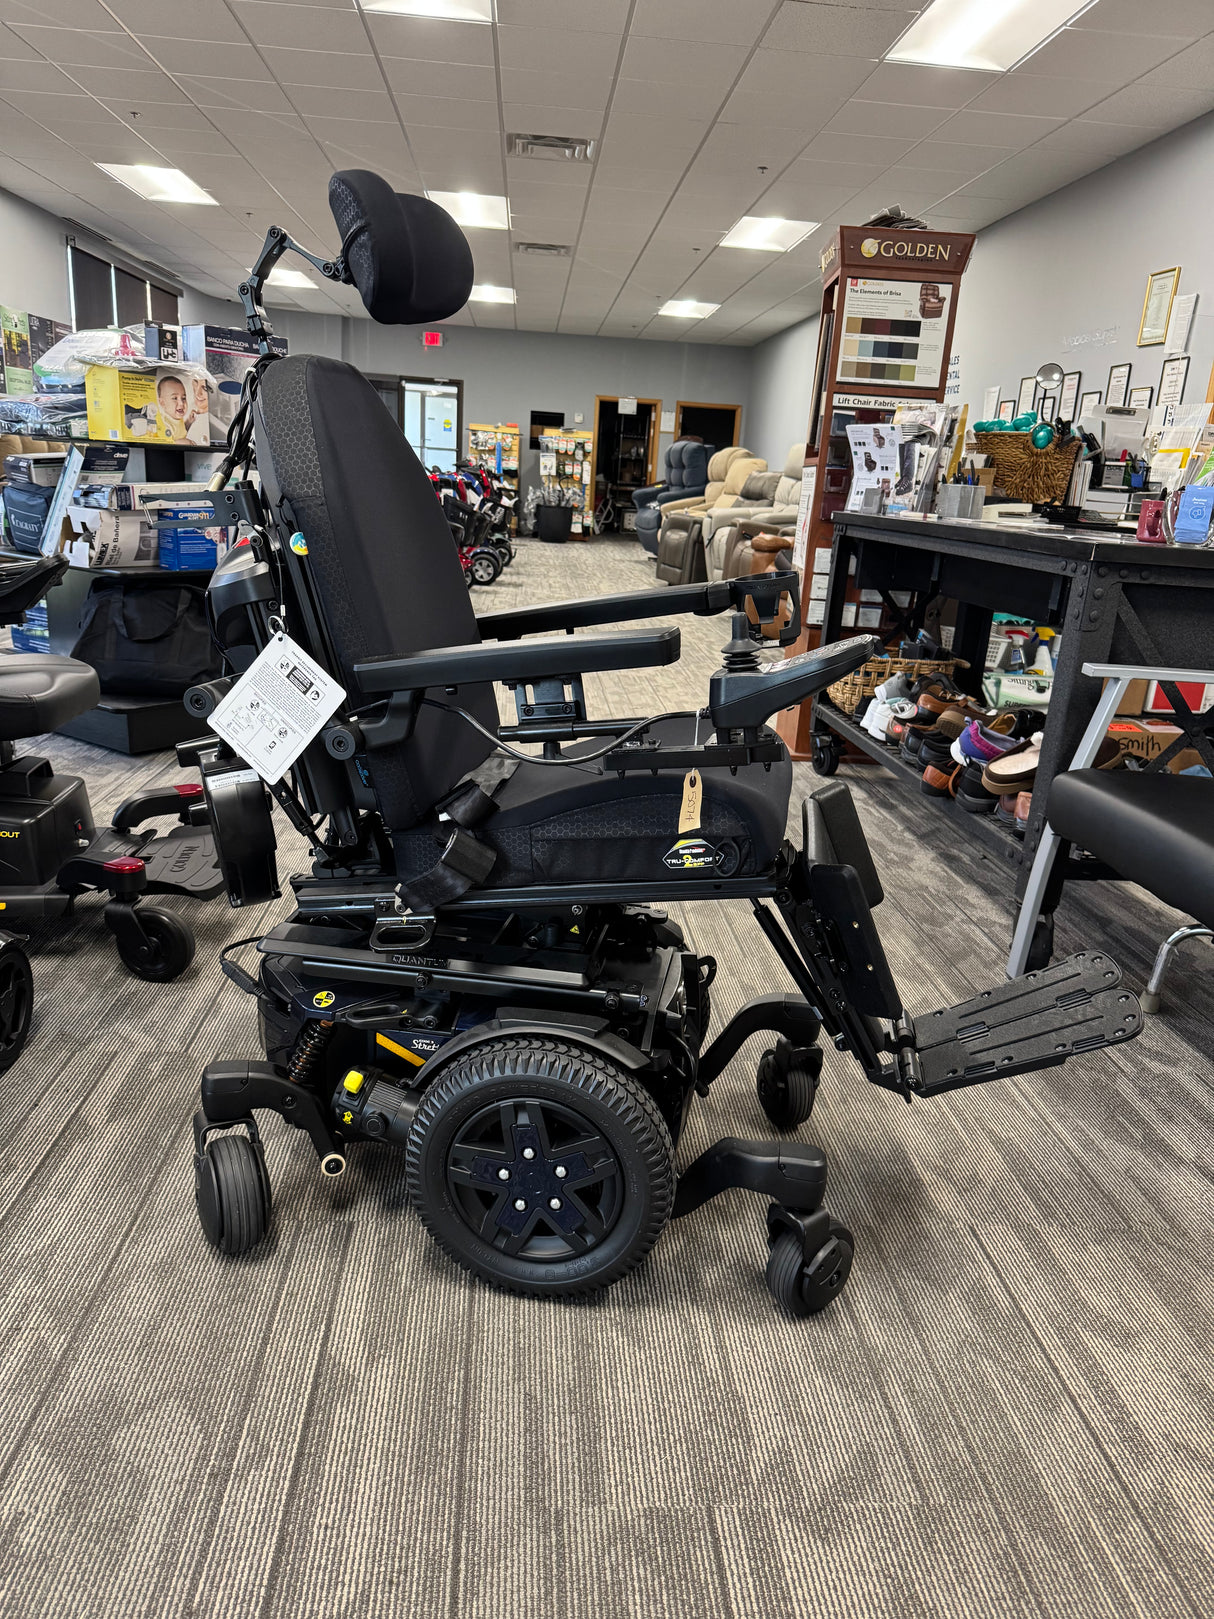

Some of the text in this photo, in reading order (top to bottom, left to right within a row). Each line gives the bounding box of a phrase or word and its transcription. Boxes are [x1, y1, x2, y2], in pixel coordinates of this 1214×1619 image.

[880, 241, 951, 261] GOLDEN
[837, 397, 850, 405] Lift
[852, 398, 872, 406] Chair
[873, 399, 896, 408] Fabric
[111, 544, 118, 553] de
